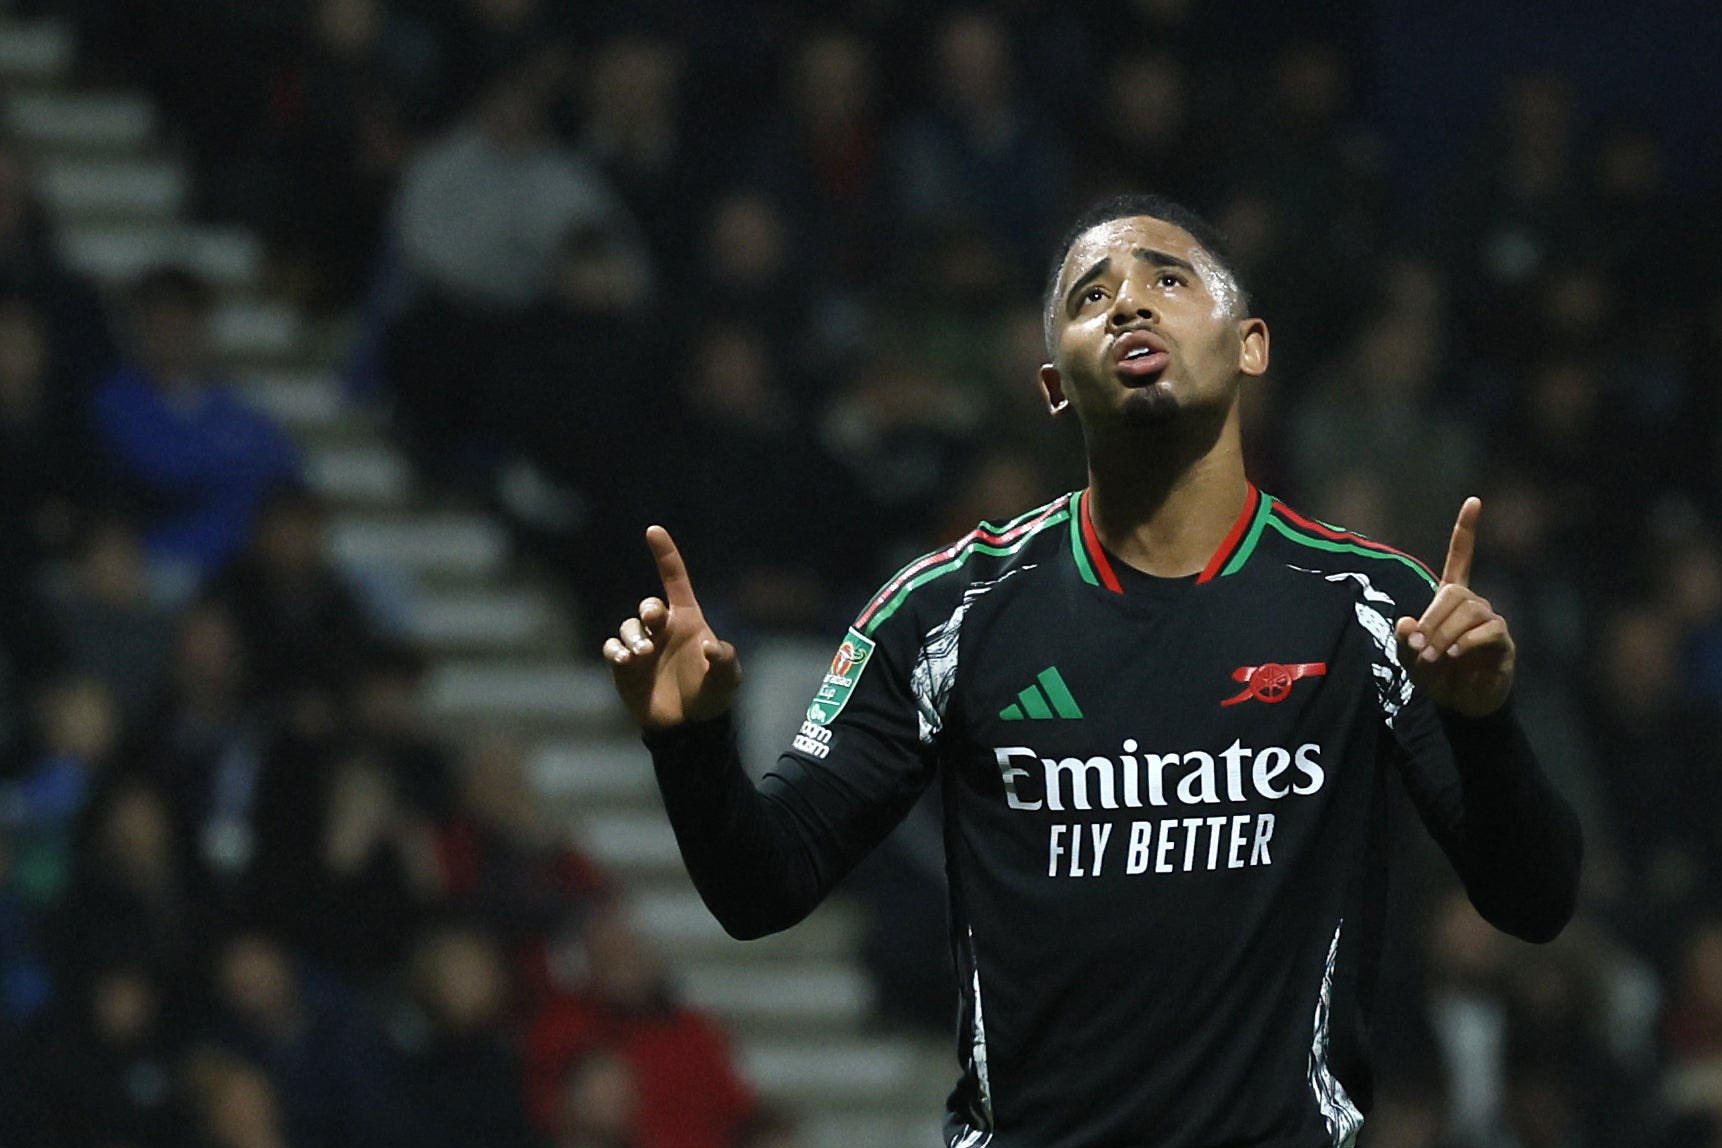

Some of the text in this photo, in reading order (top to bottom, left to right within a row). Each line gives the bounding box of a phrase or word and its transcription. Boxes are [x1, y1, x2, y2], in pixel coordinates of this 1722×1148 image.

[993, 738, 1325, 811] Emirates
[1048, 813, 1276, 877] FLY BETTER
